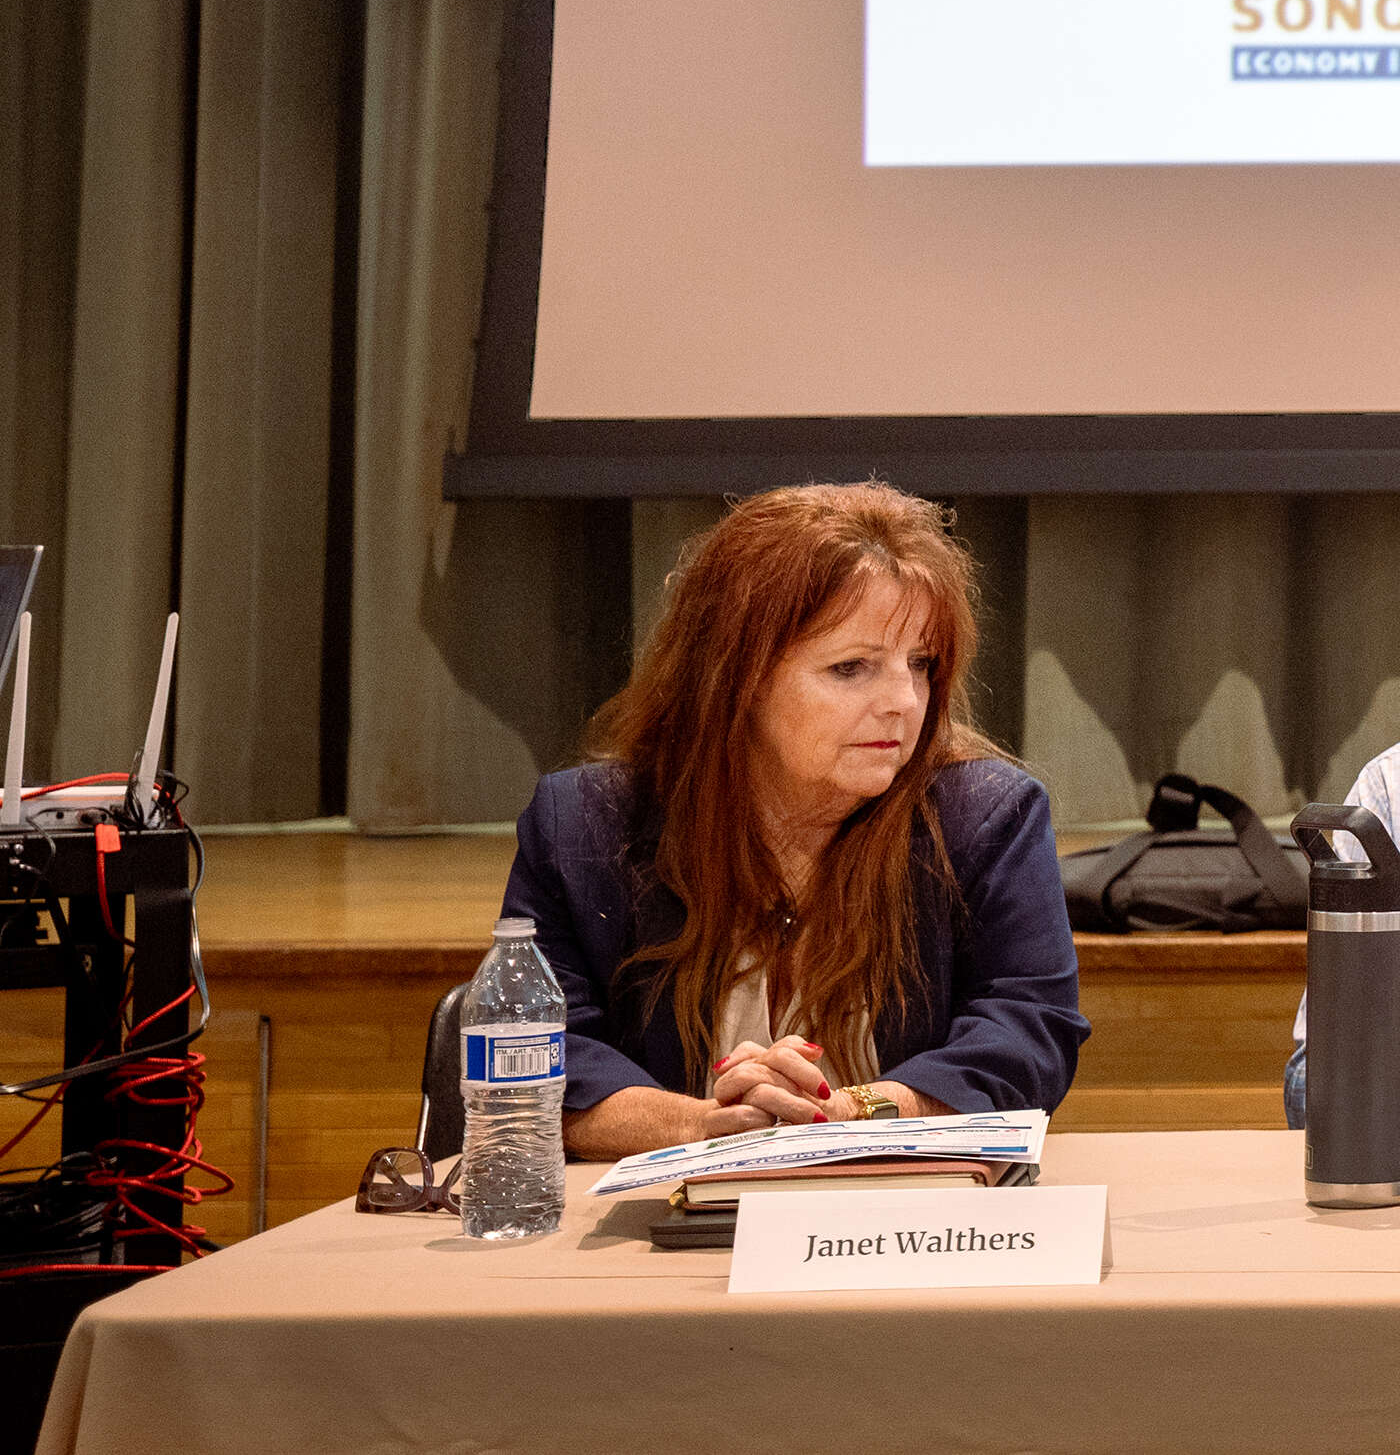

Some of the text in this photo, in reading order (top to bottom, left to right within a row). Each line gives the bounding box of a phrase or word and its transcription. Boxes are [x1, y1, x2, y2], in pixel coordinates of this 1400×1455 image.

[1235, 48, 1379, 74] ECONOMY
[803, 1227, 1035, 1263] Janet Walthers
